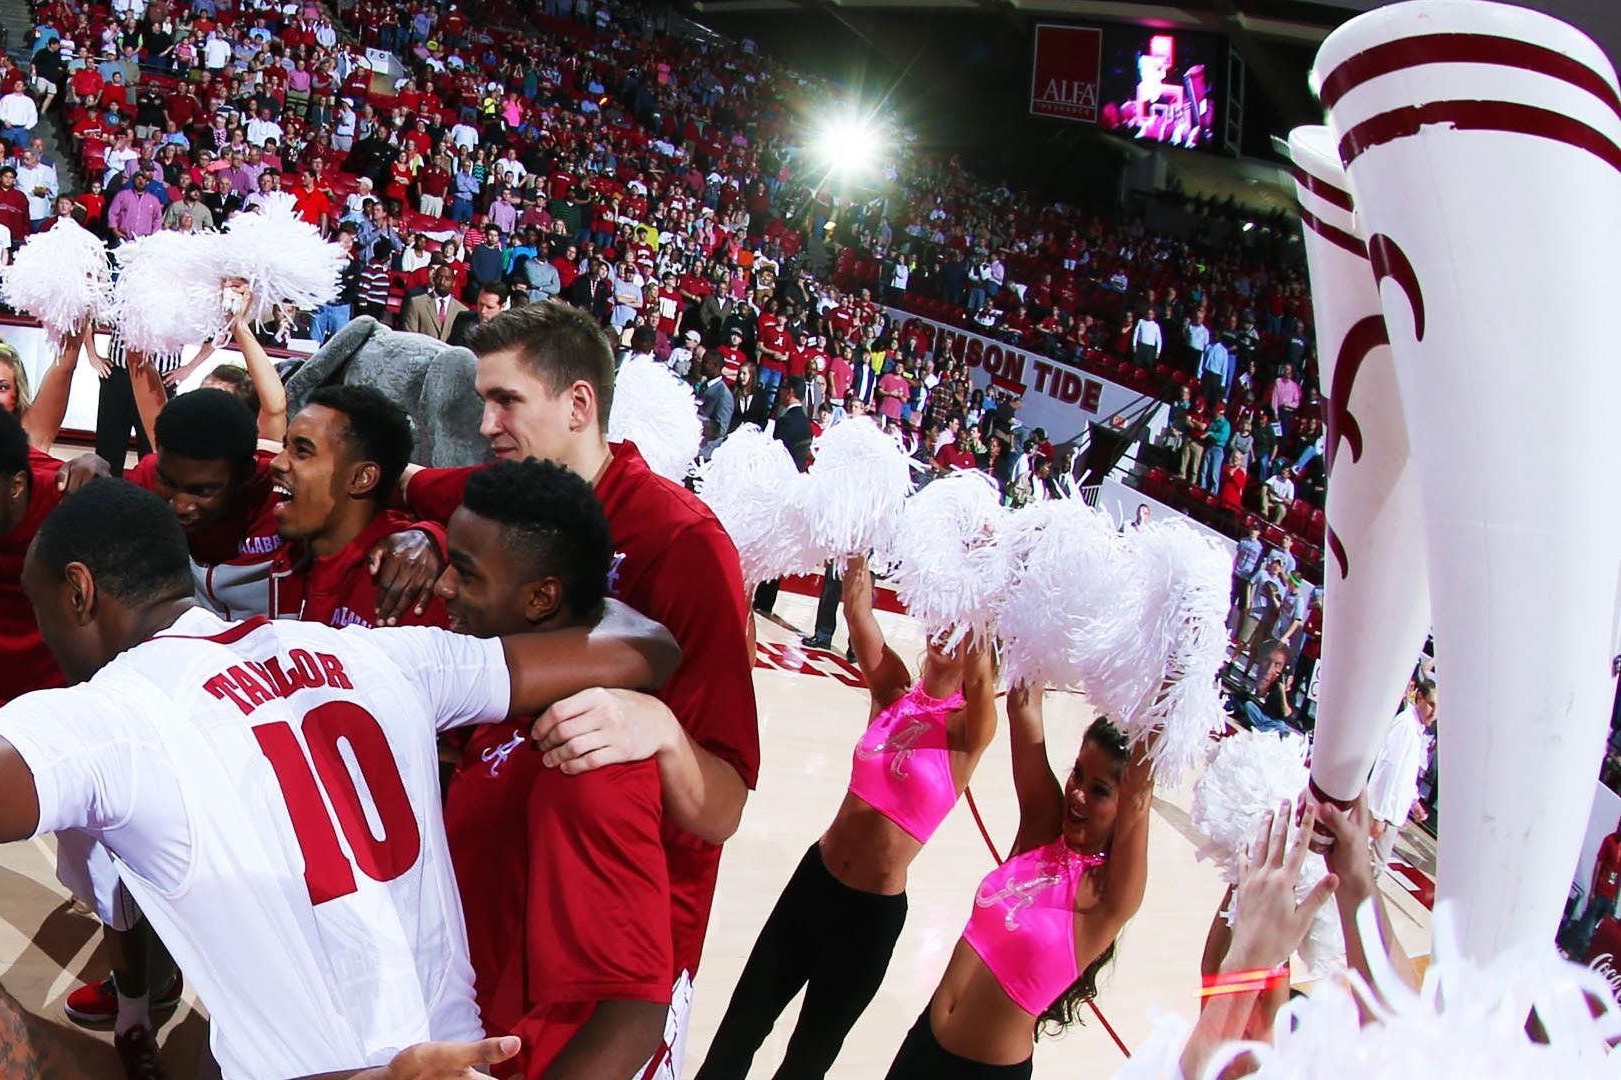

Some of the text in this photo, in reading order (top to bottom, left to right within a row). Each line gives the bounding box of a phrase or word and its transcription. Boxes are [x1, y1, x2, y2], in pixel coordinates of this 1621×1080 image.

[1043, 79, 1096, 106] ALFA
[1034, 360, 1104, 415] TIDE
[202, 648, 354, 716] TAYLOR
[251, 700, 421, 906] 10
